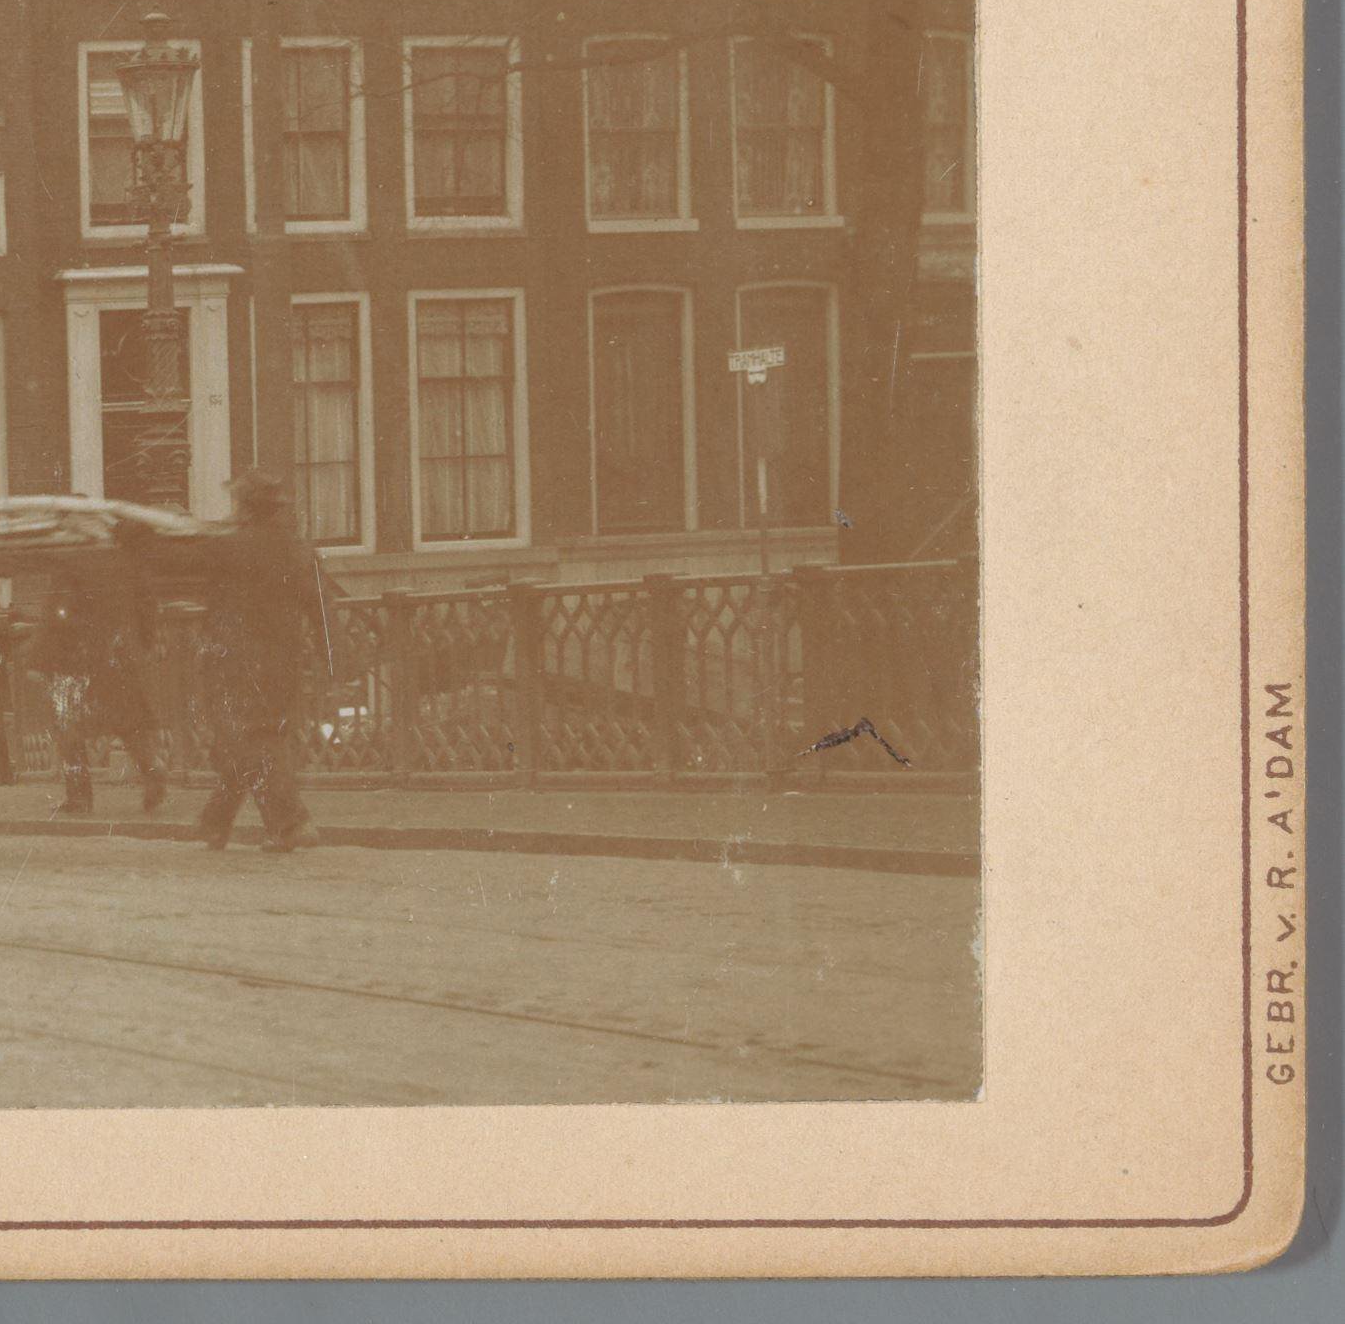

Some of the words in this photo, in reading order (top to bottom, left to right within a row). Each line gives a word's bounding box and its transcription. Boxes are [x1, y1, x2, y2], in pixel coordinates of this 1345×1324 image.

[1264, 681, 1294, 834] A'DAM
[1267, 853, 1297, 890] R.
[1266, 961, 1297, 1086] GEBR.
